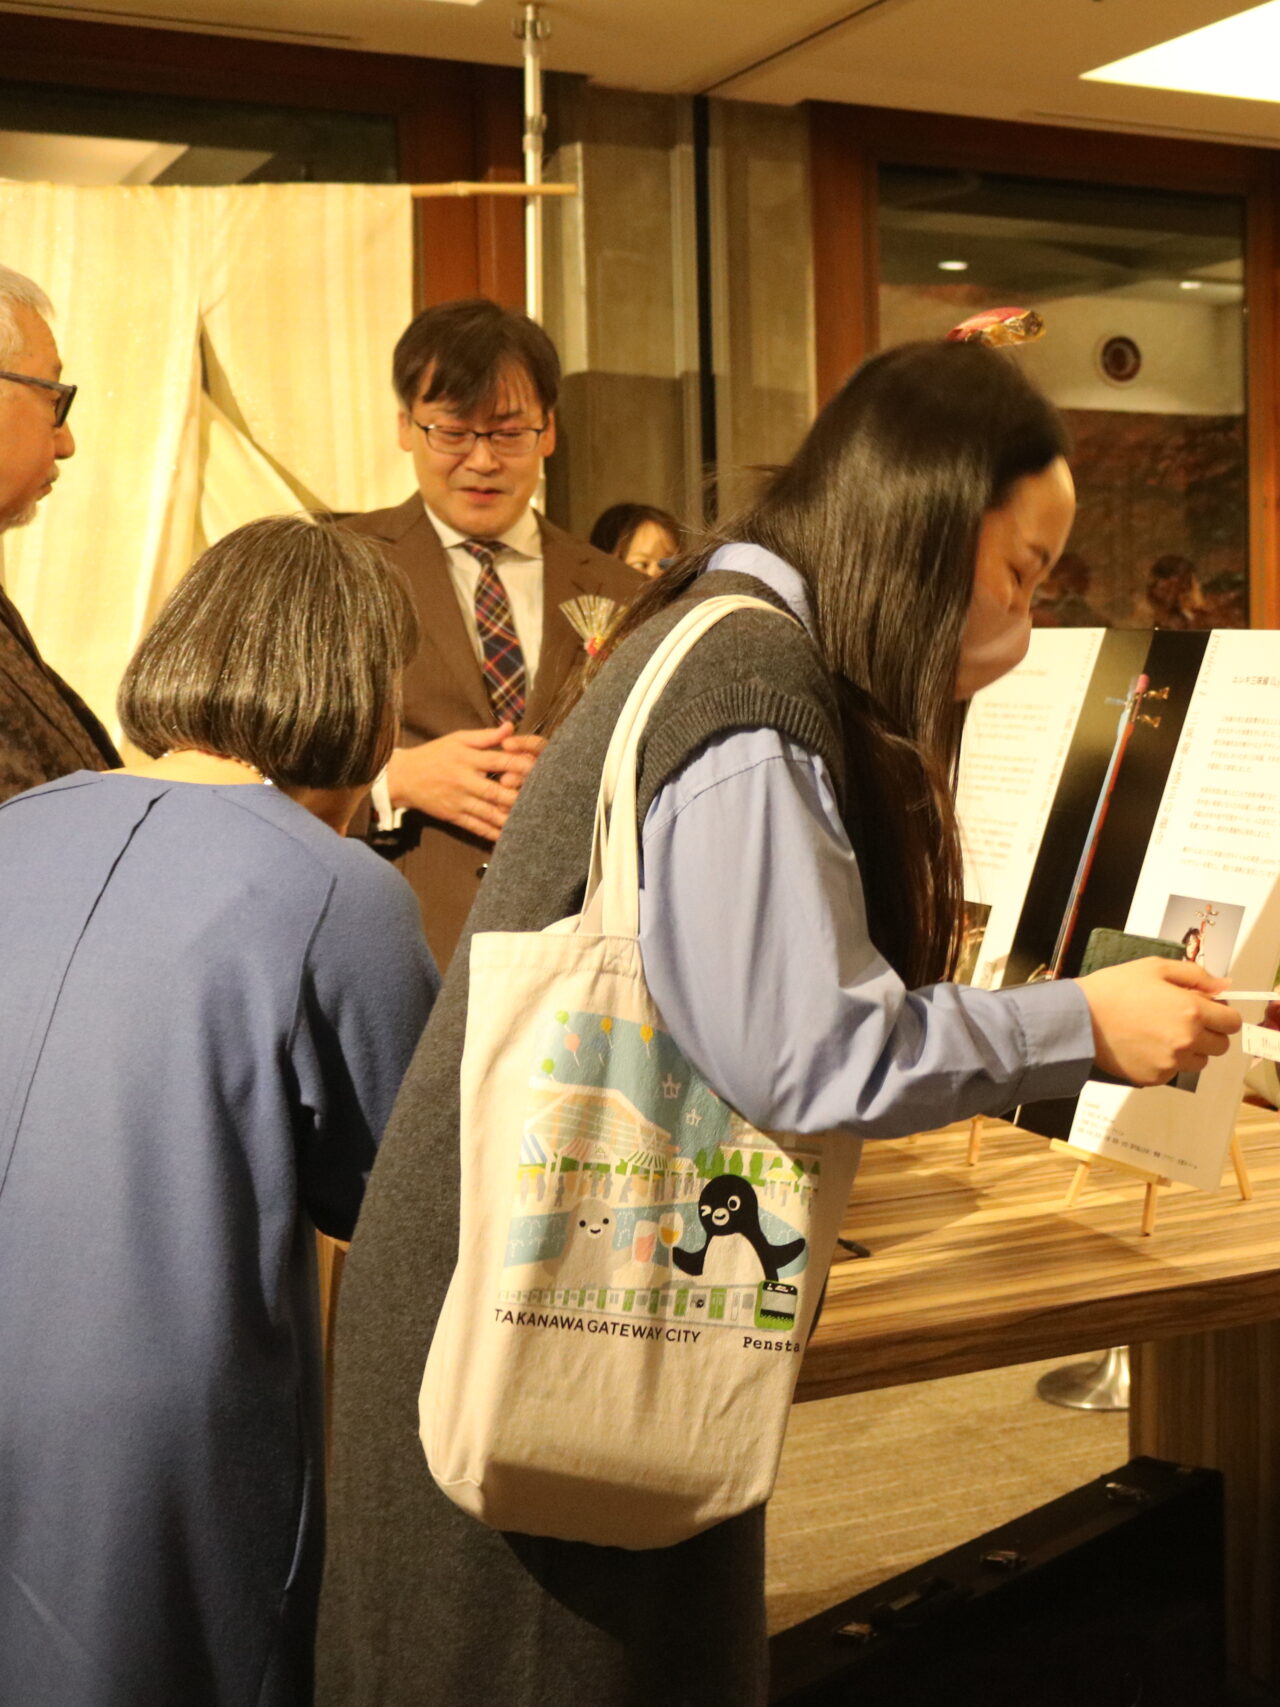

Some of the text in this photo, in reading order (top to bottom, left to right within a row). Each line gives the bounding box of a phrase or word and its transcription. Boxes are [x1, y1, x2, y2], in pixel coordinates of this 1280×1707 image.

[494, 1308, 701, 1343] TAKANAWA GATEWAY CITY
[742, 1336, 801, 1353] Pensta
